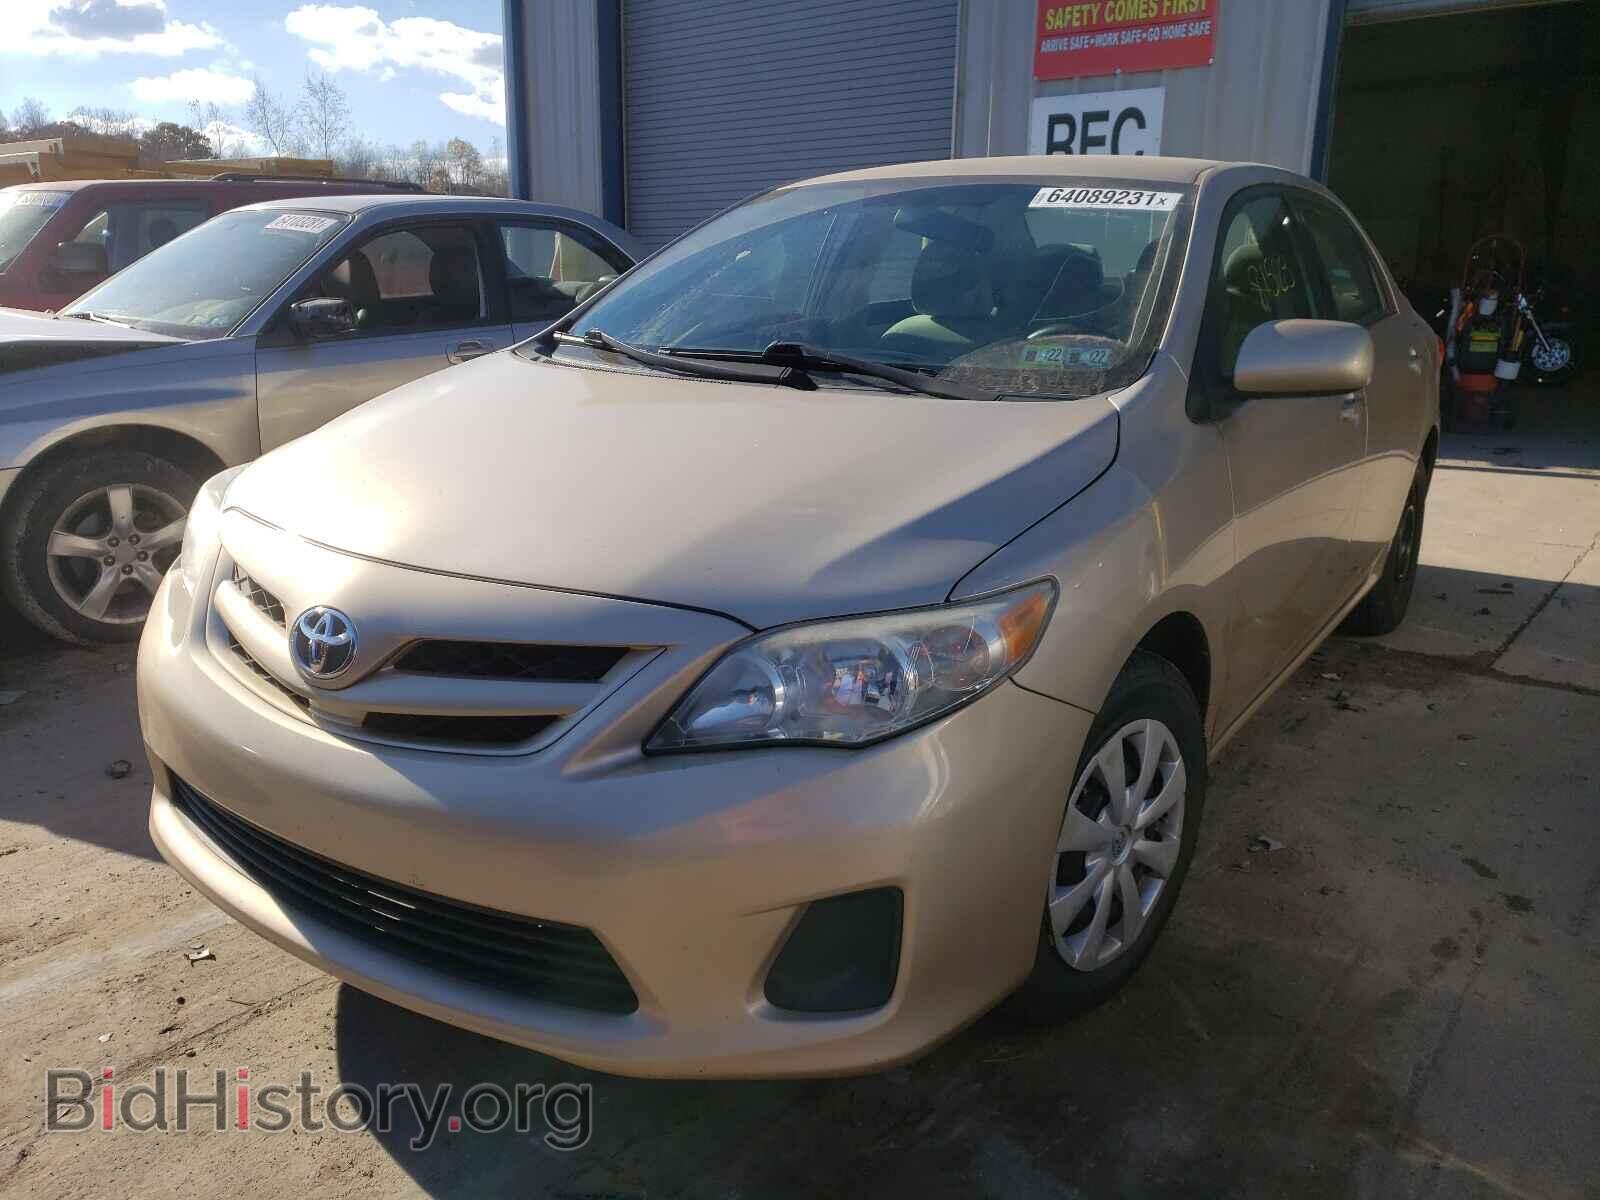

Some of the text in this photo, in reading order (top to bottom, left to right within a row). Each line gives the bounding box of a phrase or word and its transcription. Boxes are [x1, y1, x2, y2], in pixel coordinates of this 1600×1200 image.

[1045, 4, 1102, 31] SAFETY
[1104, 0, 1158, 23] COMES
[1188, 20, 1212, 37] SAFE
